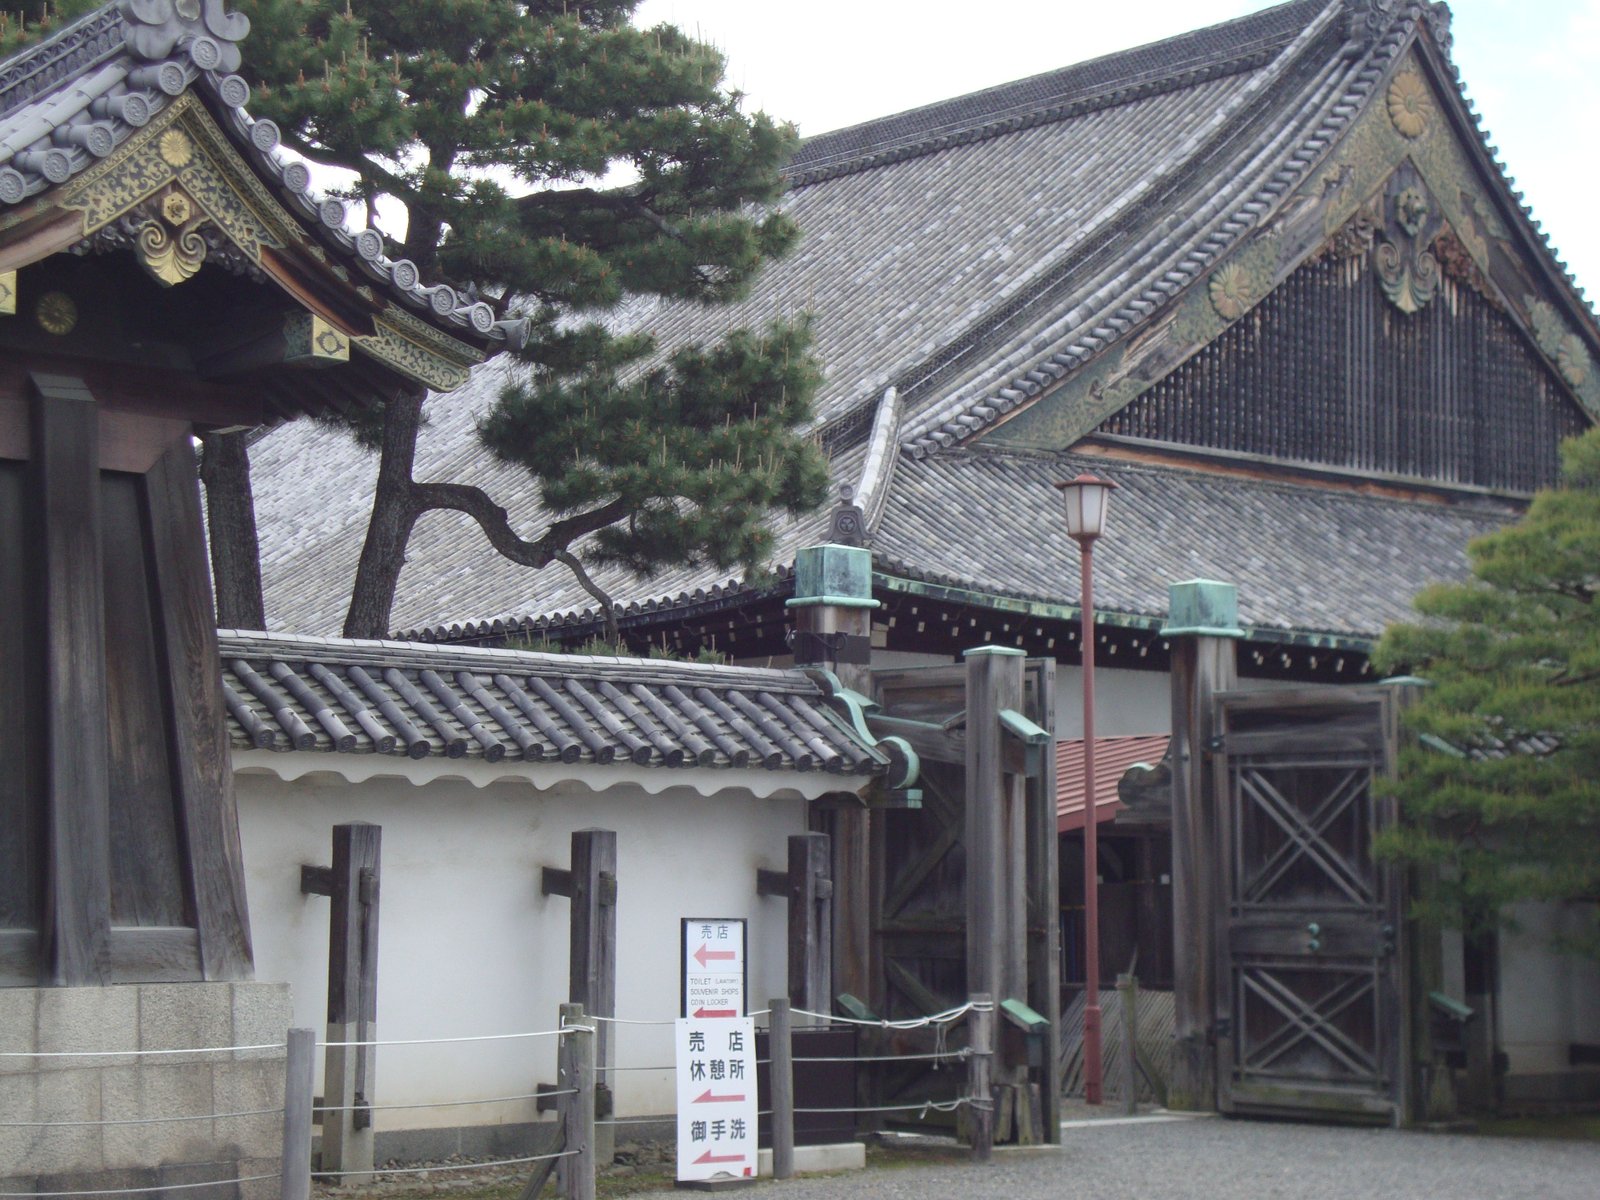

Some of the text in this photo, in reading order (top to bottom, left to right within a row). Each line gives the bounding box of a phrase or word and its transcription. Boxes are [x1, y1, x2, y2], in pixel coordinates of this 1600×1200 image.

[701, 924, 728, 939] 売店
[690, 977, 711, 985] TOILET
[690, 988, 739, 996] SOUVENIR SHOPS
[689, 1031, 743, 1052] 売店
[690, 1059, 744, 1081] 休憩所
[691, 1118, 746, 1142] 御手洗
